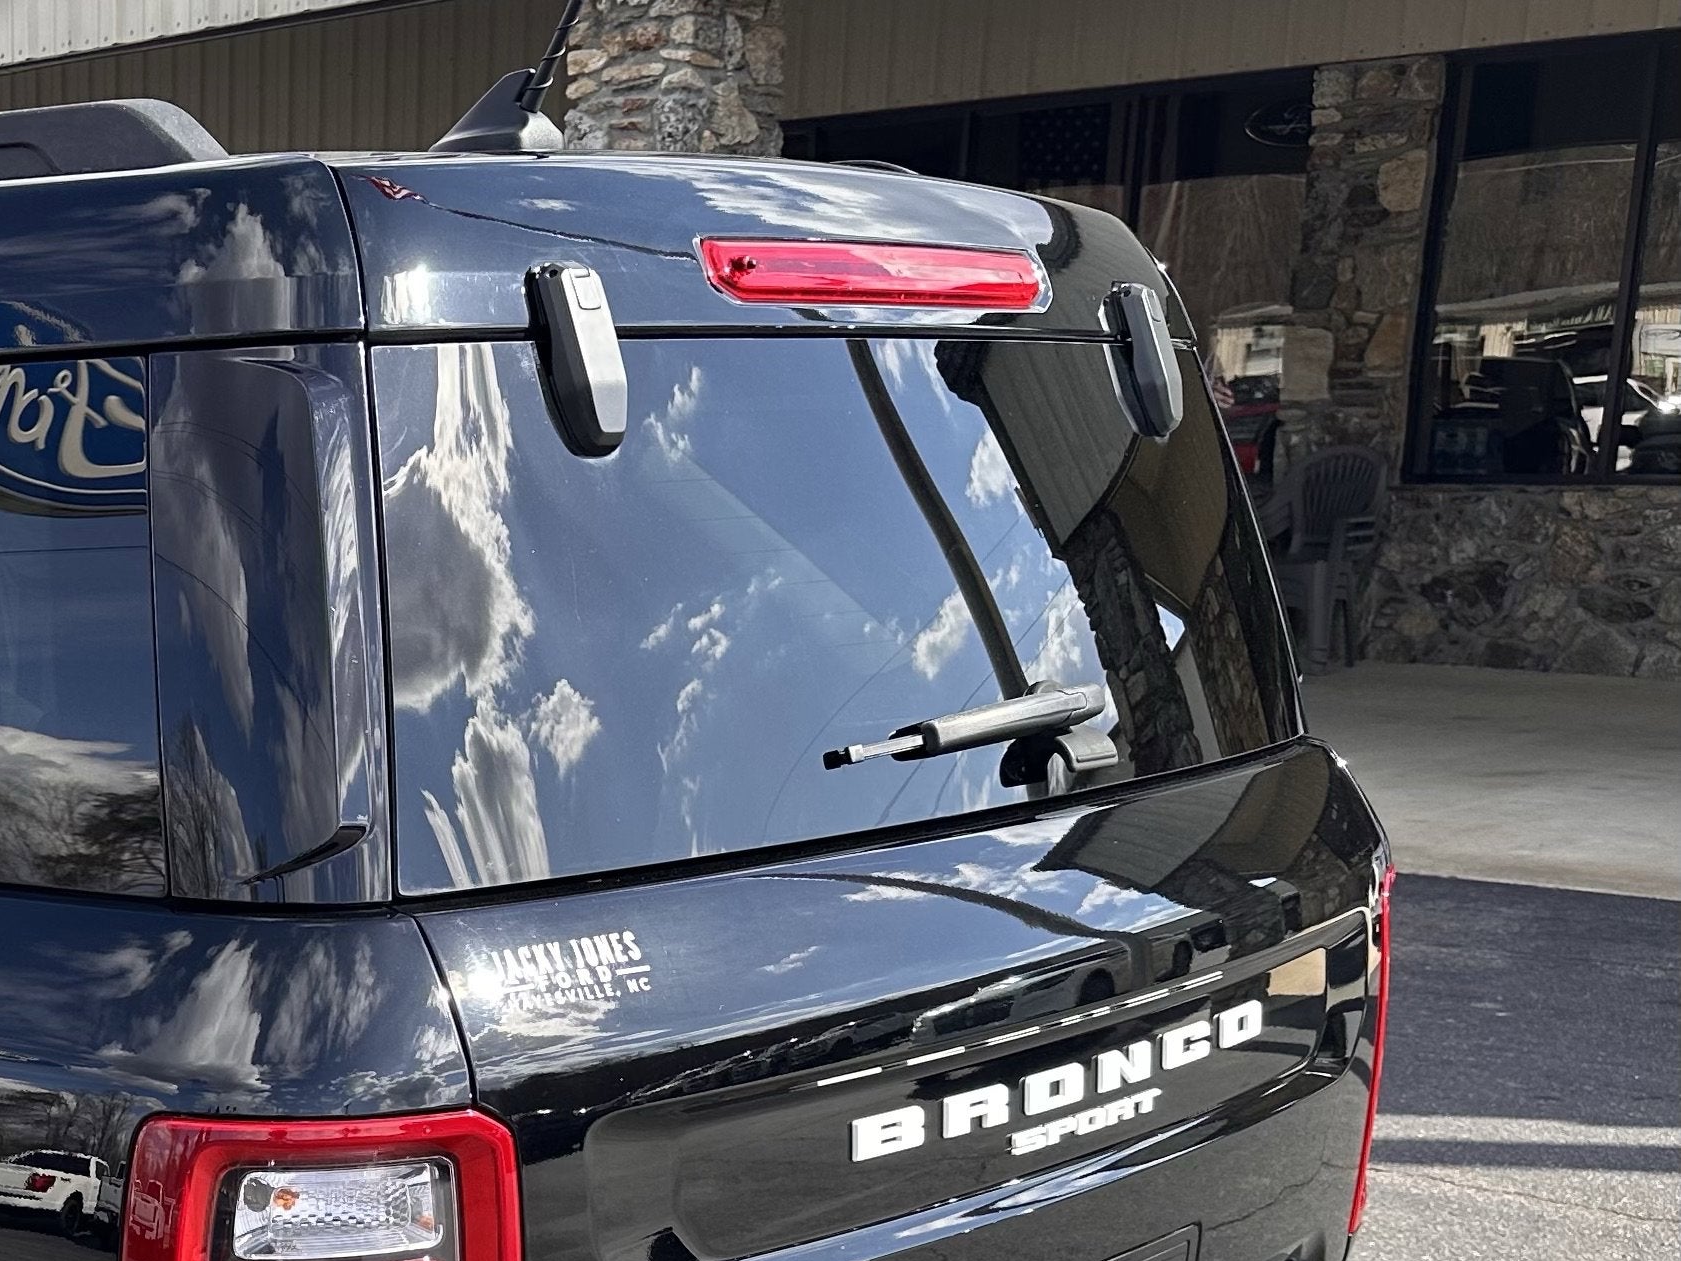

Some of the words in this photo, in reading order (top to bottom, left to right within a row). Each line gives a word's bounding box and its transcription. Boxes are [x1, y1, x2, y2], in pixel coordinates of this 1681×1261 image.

[567, 930, 642, 969] JONES
[537, 965, 613, 992] FORD
[626, 977, 652, 994] NC
[851, 999, 1262, 1163] BRONCO
[1009, 1088, 1162, 1156] SPORT
